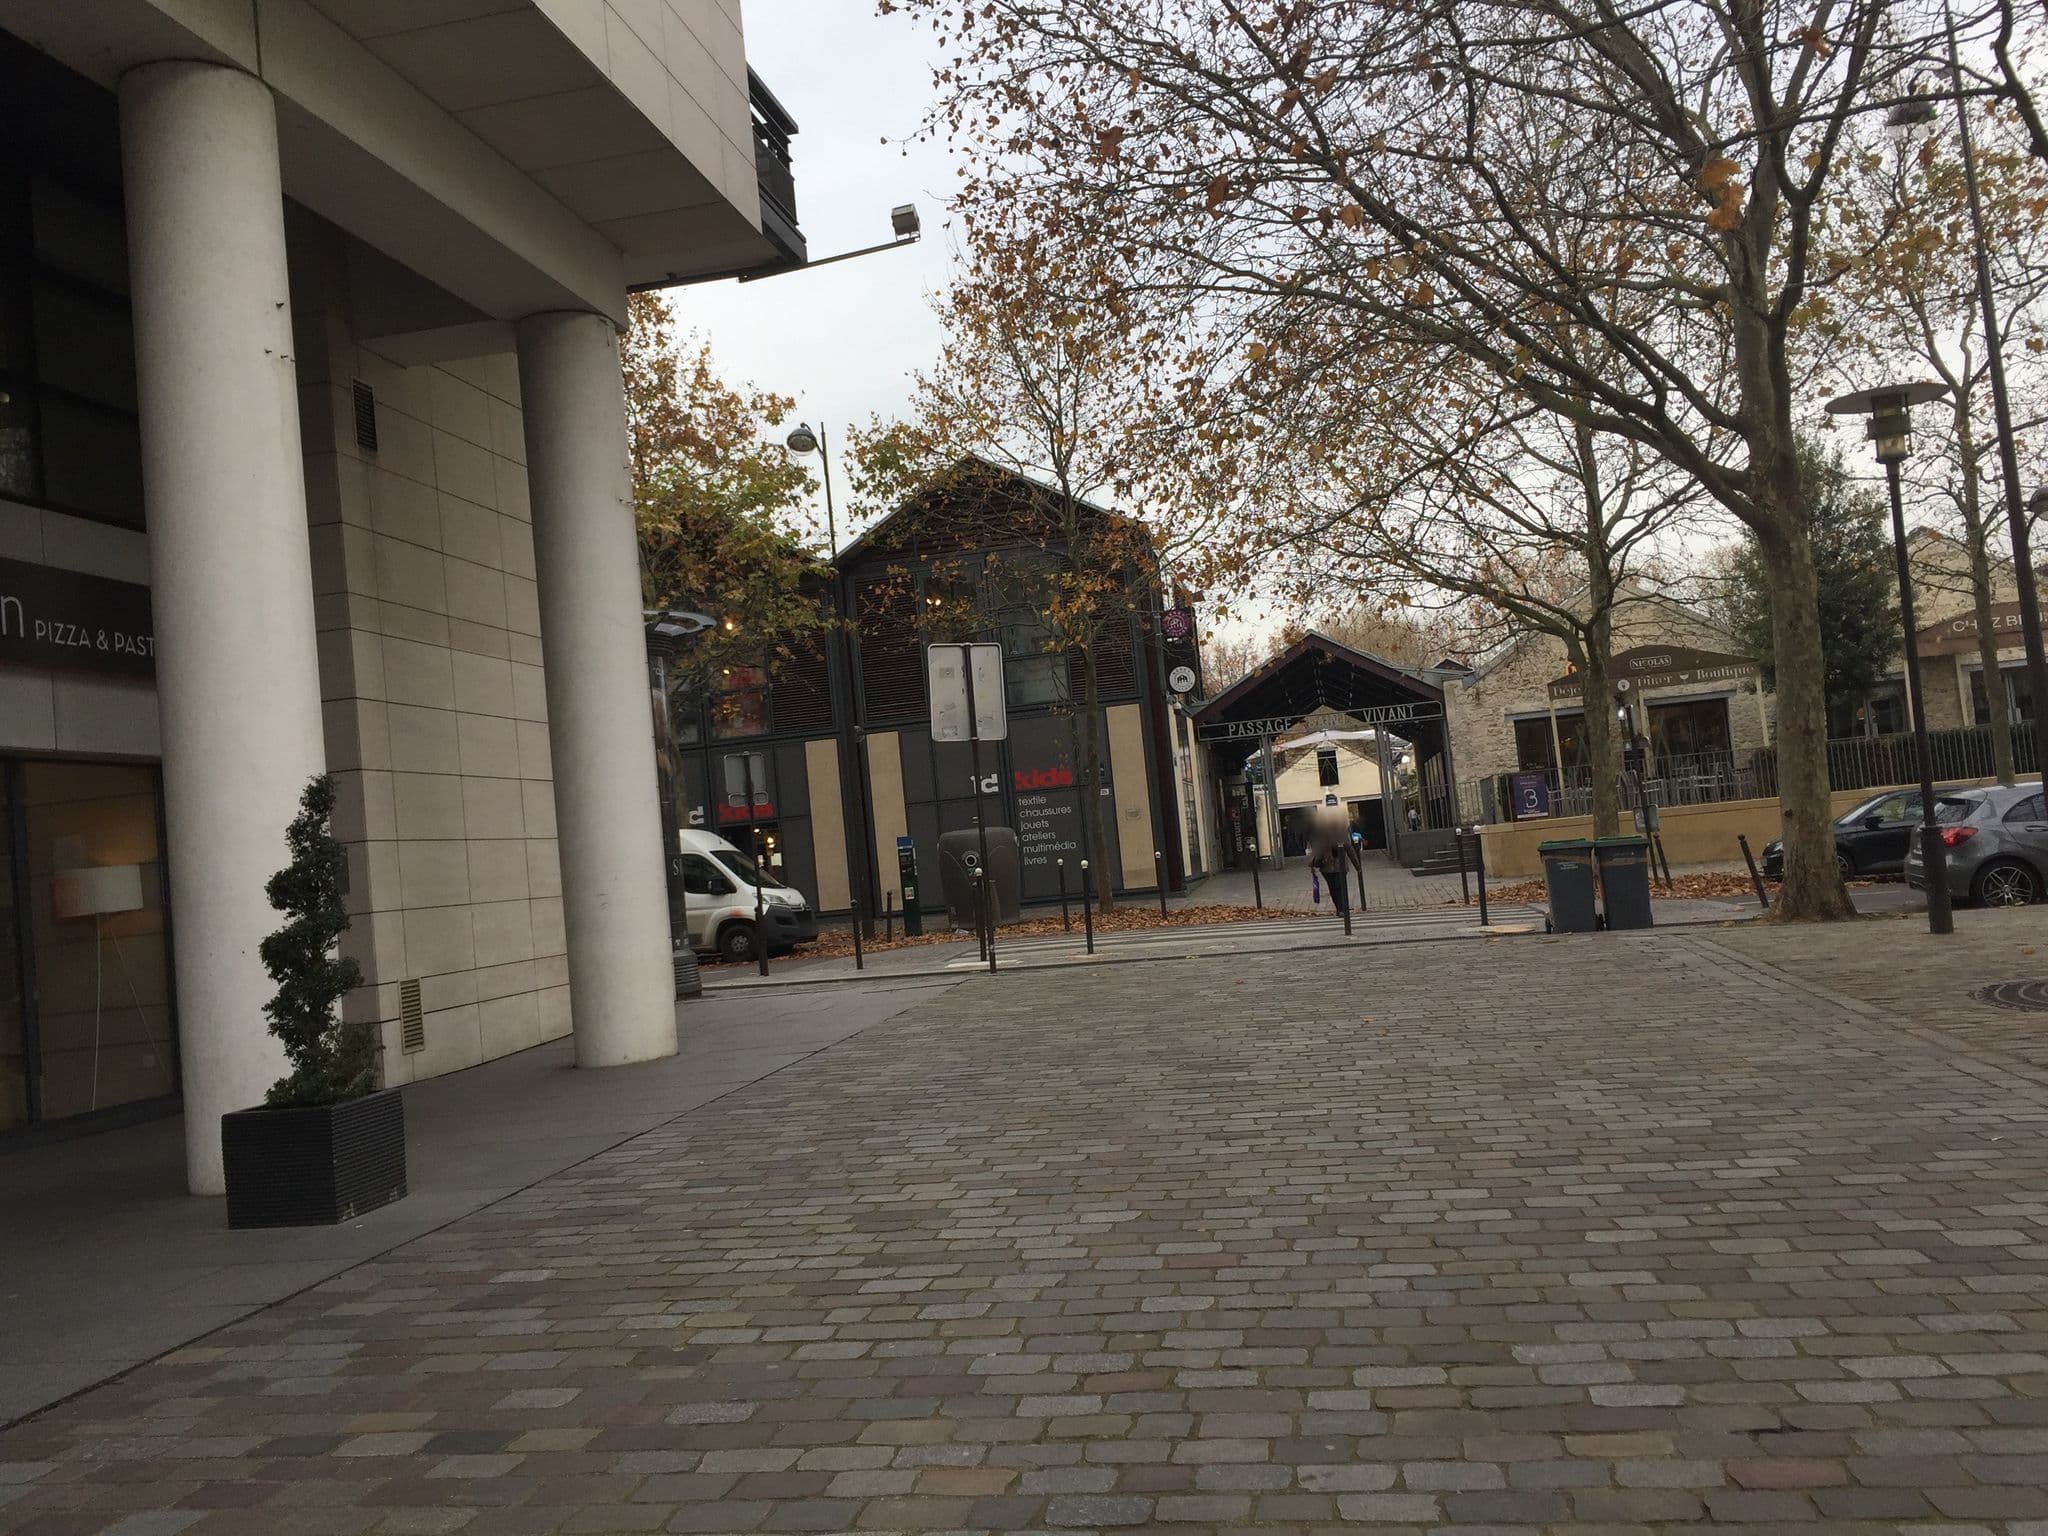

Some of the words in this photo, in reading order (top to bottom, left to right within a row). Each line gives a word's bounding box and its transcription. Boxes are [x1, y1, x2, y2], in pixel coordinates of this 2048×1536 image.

[1952, 616, 2001, 632] CHZ
[34, 619, 91, 648] PIZZA
[96, 629, 108, 650] &
[114, 631, 155, 656] PAST
[1631, 656, 1670, 668] NICOLAS
[1697, 666, 1754, 680] Boutique
[1227, 717, 1292, 737] PASSAGE
[1362, 704, 1414, 722] VIVANT
[1018, 796, 1047, 806] textile
[1523, 788, 1538, 808] 3
[1019, 806, 1072, 818] chaussures
[1020, 820, 1049, 832] jouets
[1021, 831, 1056, 842] ateliers
[1023, 841, 1077, 854] multimédia
[1023, 856, 1047, 866] livres
